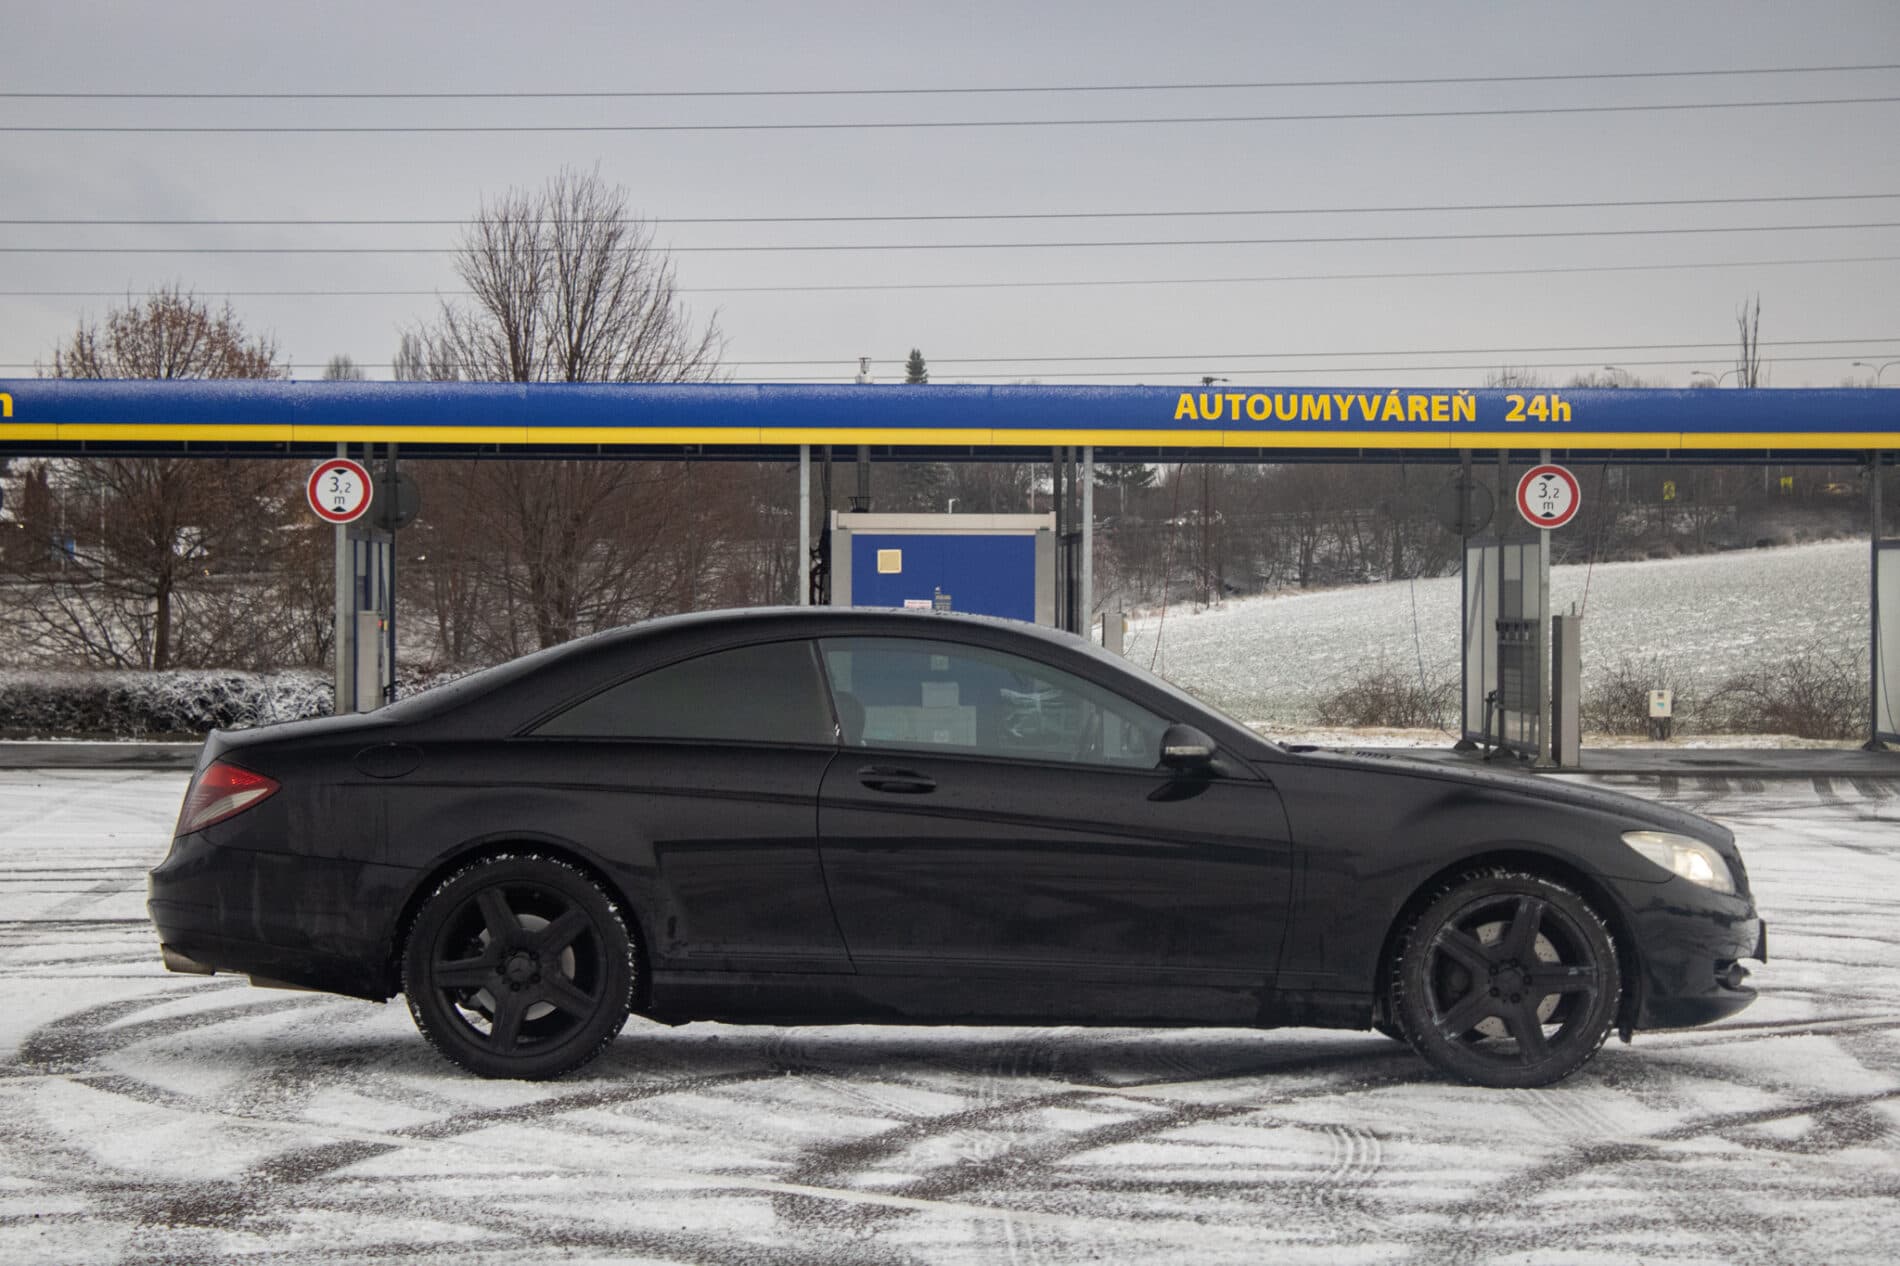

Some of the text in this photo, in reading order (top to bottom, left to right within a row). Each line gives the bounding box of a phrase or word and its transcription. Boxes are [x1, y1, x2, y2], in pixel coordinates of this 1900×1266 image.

[1174, 389, 1572, 422] AUTOUMYVÁREŇ 24h
[1538, 482, 1560, 500] 3,2
[334, 496, 345, 505] m
[1543, 501, 1554, 511] m
